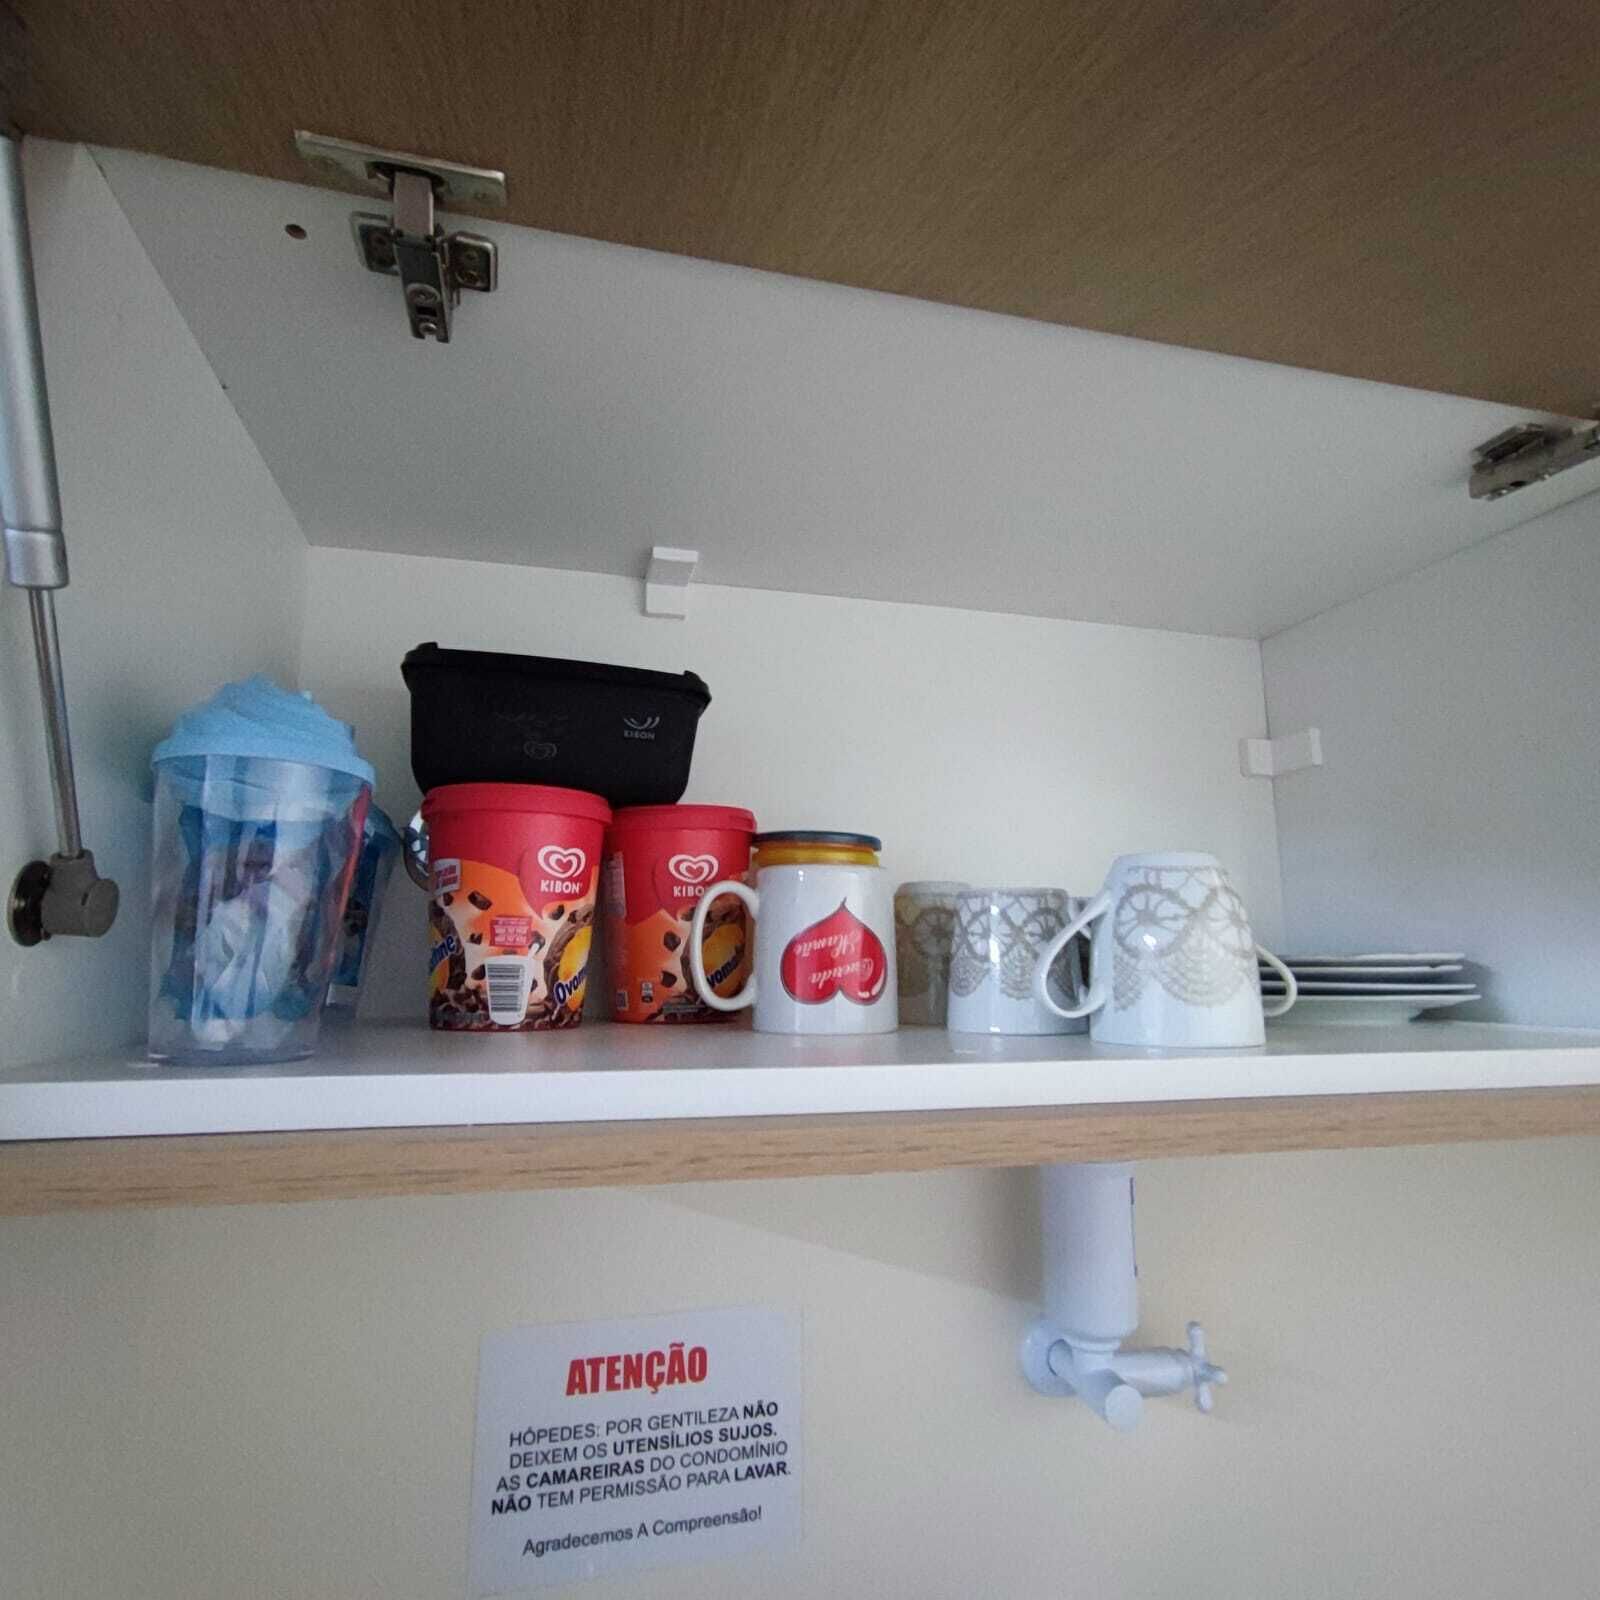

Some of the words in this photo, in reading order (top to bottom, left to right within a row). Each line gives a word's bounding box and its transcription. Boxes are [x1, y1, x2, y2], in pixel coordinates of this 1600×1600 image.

[540, 879, 581, 894] KIBON
[673, 885, 705, 898] KIBO
[565, 1342, 708, 1396] ATENÇÃO
[509, 1422, 600, 1448] HÓPEDES:
[606, 1419, 643, 1436] POR
[647, 1406, 740, 1431] GENTILEZA
[743, 1400, 778, 1420] NÃO
[509, 1447, 578, 1470] DEIXEM
[583, 1443, 608, 1460] OS
[613, 1429, 714, 1457] UTENSÍLIOS
[718, 1422, 778, 1443] SUJOS.
[491, 1494, 532, 1516] NÃO
[537, 1488, 575, 1510] TEM
[579, 1475, 682, 1504] PERMISSÃO
[686, 1469, 731, 1489] PARA
[734, 1461, 792, 1483] LAVAR.
[496, 1475, 521, 1493] AS
[526, 1459, 645, 1489] CAMAREIRAS
[650, 1455, 676, 1473] DO
[680, 1440, 788, 1468] CONDOMÍNIO
[522, 1527, 633, 1558] Agradecemos
[637, 1522, 649, 1538] A
[652, 1506, 763, 1537] Compreensão!
